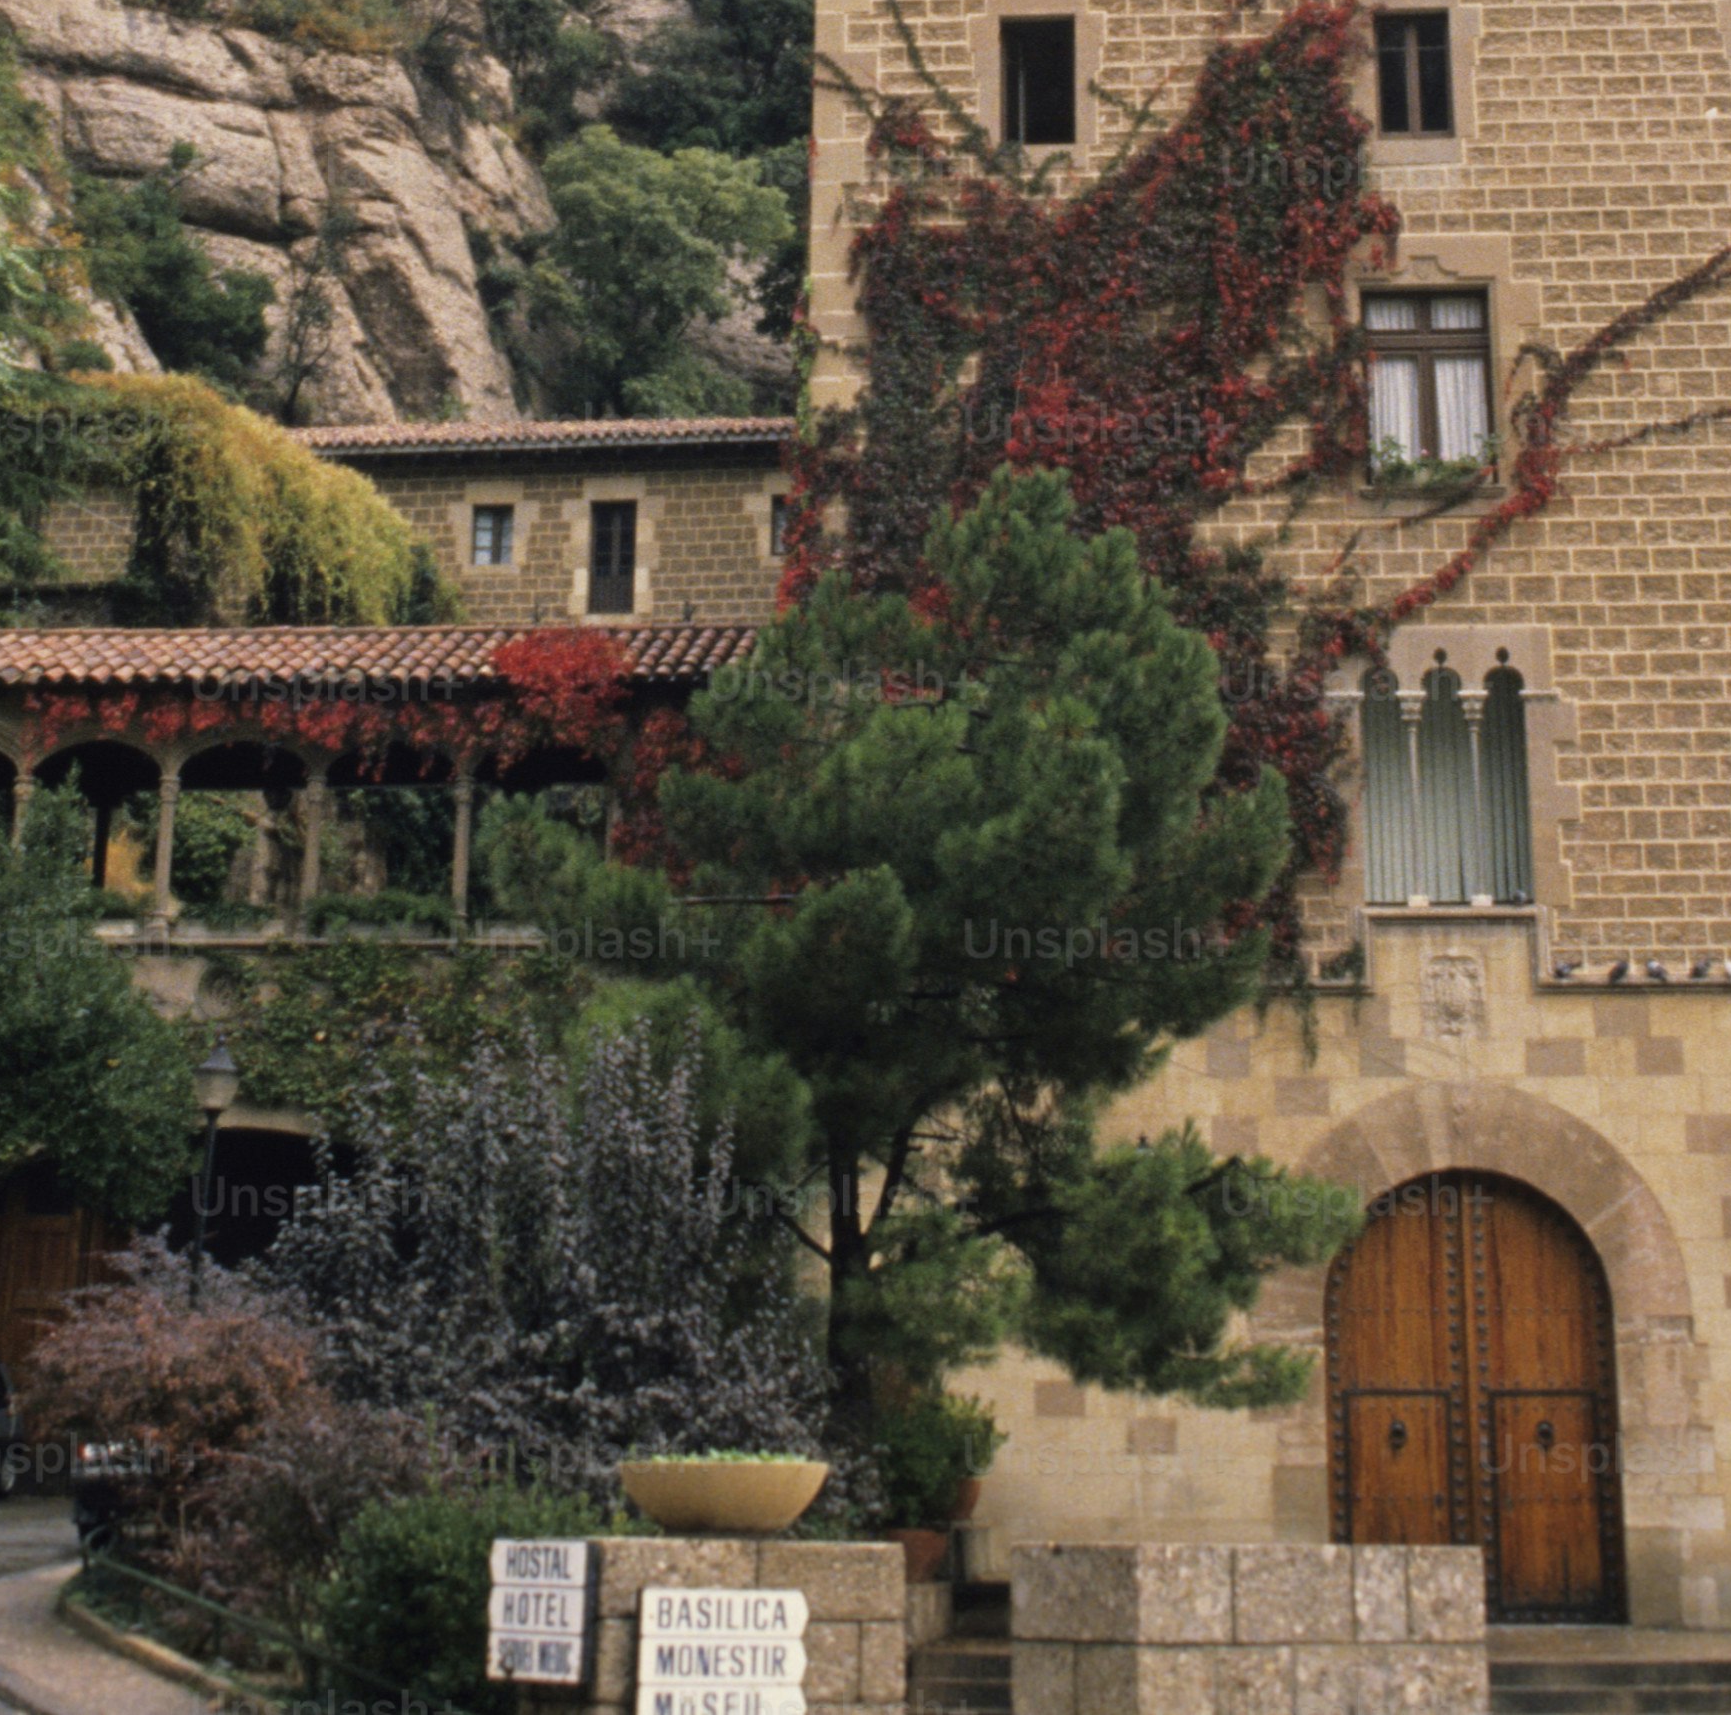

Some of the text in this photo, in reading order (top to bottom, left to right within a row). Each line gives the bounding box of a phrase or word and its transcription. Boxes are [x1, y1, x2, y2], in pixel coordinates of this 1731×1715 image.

[505, 1545, 572, 1580] HOSTAL
[502, 1592, 570, 1628] HOTEL
[656, 1596, 788, 1631] BASILICA
[655, 1644, 787, 1677] MONESTIR
